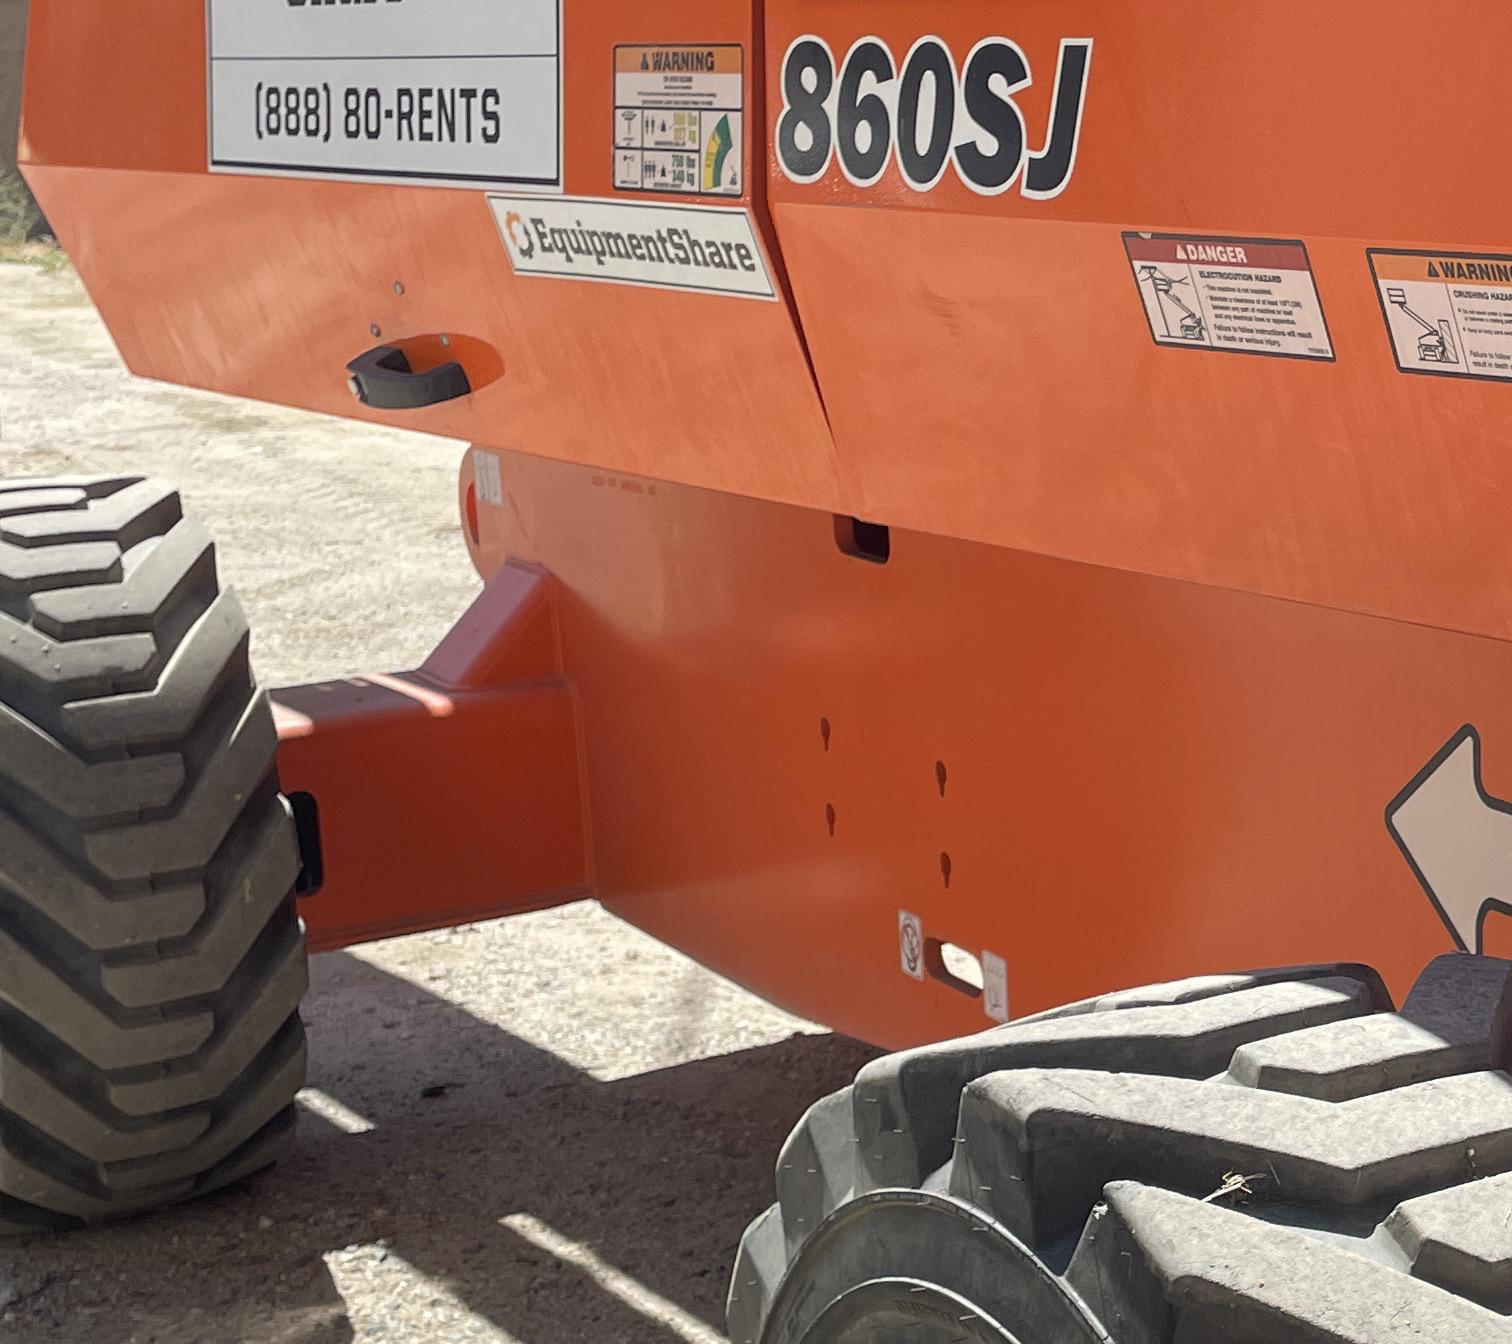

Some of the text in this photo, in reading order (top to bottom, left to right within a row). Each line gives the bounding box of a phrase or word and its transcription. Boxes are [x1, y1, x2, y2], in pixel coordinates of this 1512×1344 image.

[652, 51, 715, 71] WARNING
[255, 80, 501, 144] (888) 80-RENTS
[777, 36, 1092, 197] 860SJ
[530, 217, 756, 272] EquipmentShare
[1185, 244, 1248, 264] DANGER
[1199, 270, 1282, 283] ELECTROCUTION HAZARD
[1453, 289, 1489, 301] CRUSHING
